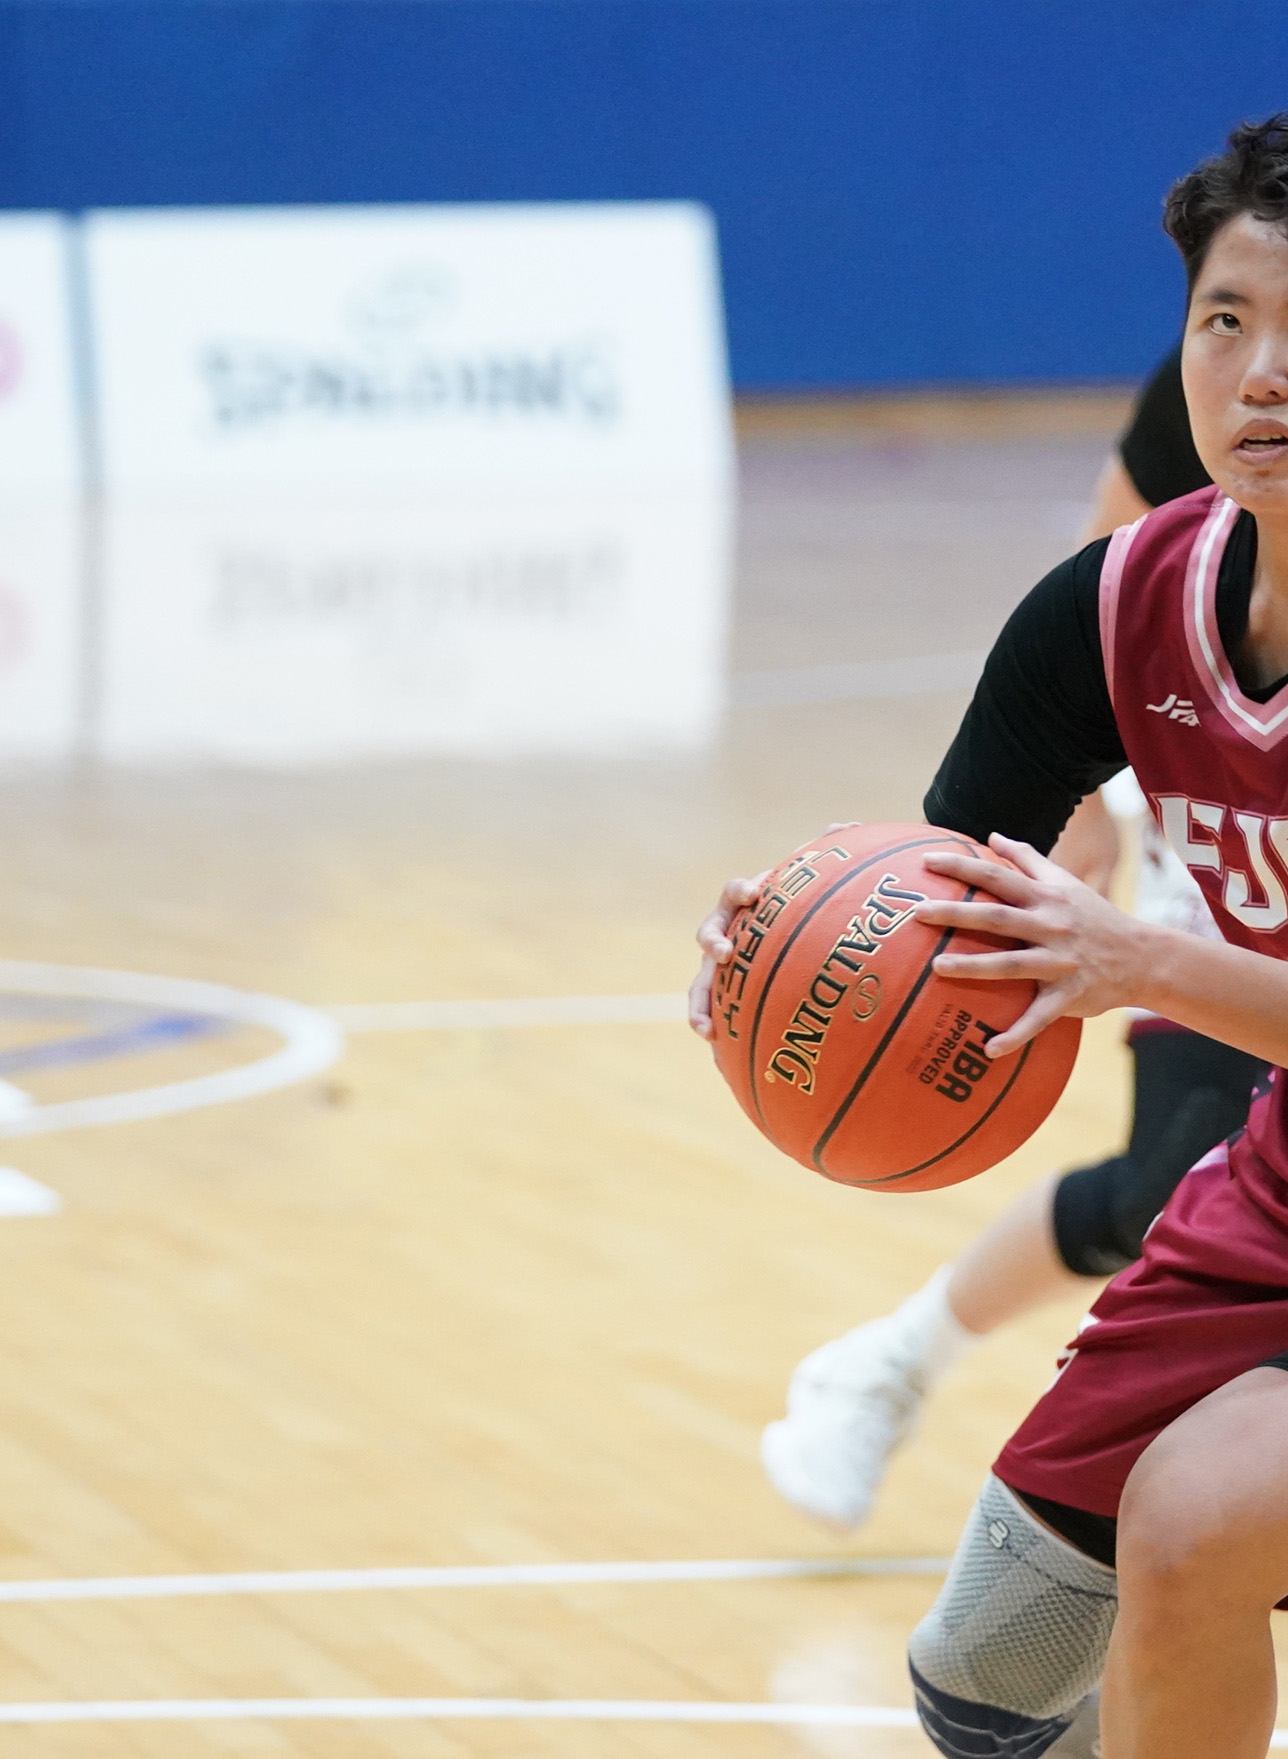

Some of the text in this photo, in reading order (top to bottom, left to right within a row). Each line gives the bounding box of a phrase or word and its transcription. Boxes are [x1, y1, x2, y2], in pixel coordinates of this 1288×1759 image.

[720, 845, 852, 1040] LEGACY
[770, 872, 929, 1096] SPALDING
[918, 1009, 973, 1085] APPROVED
